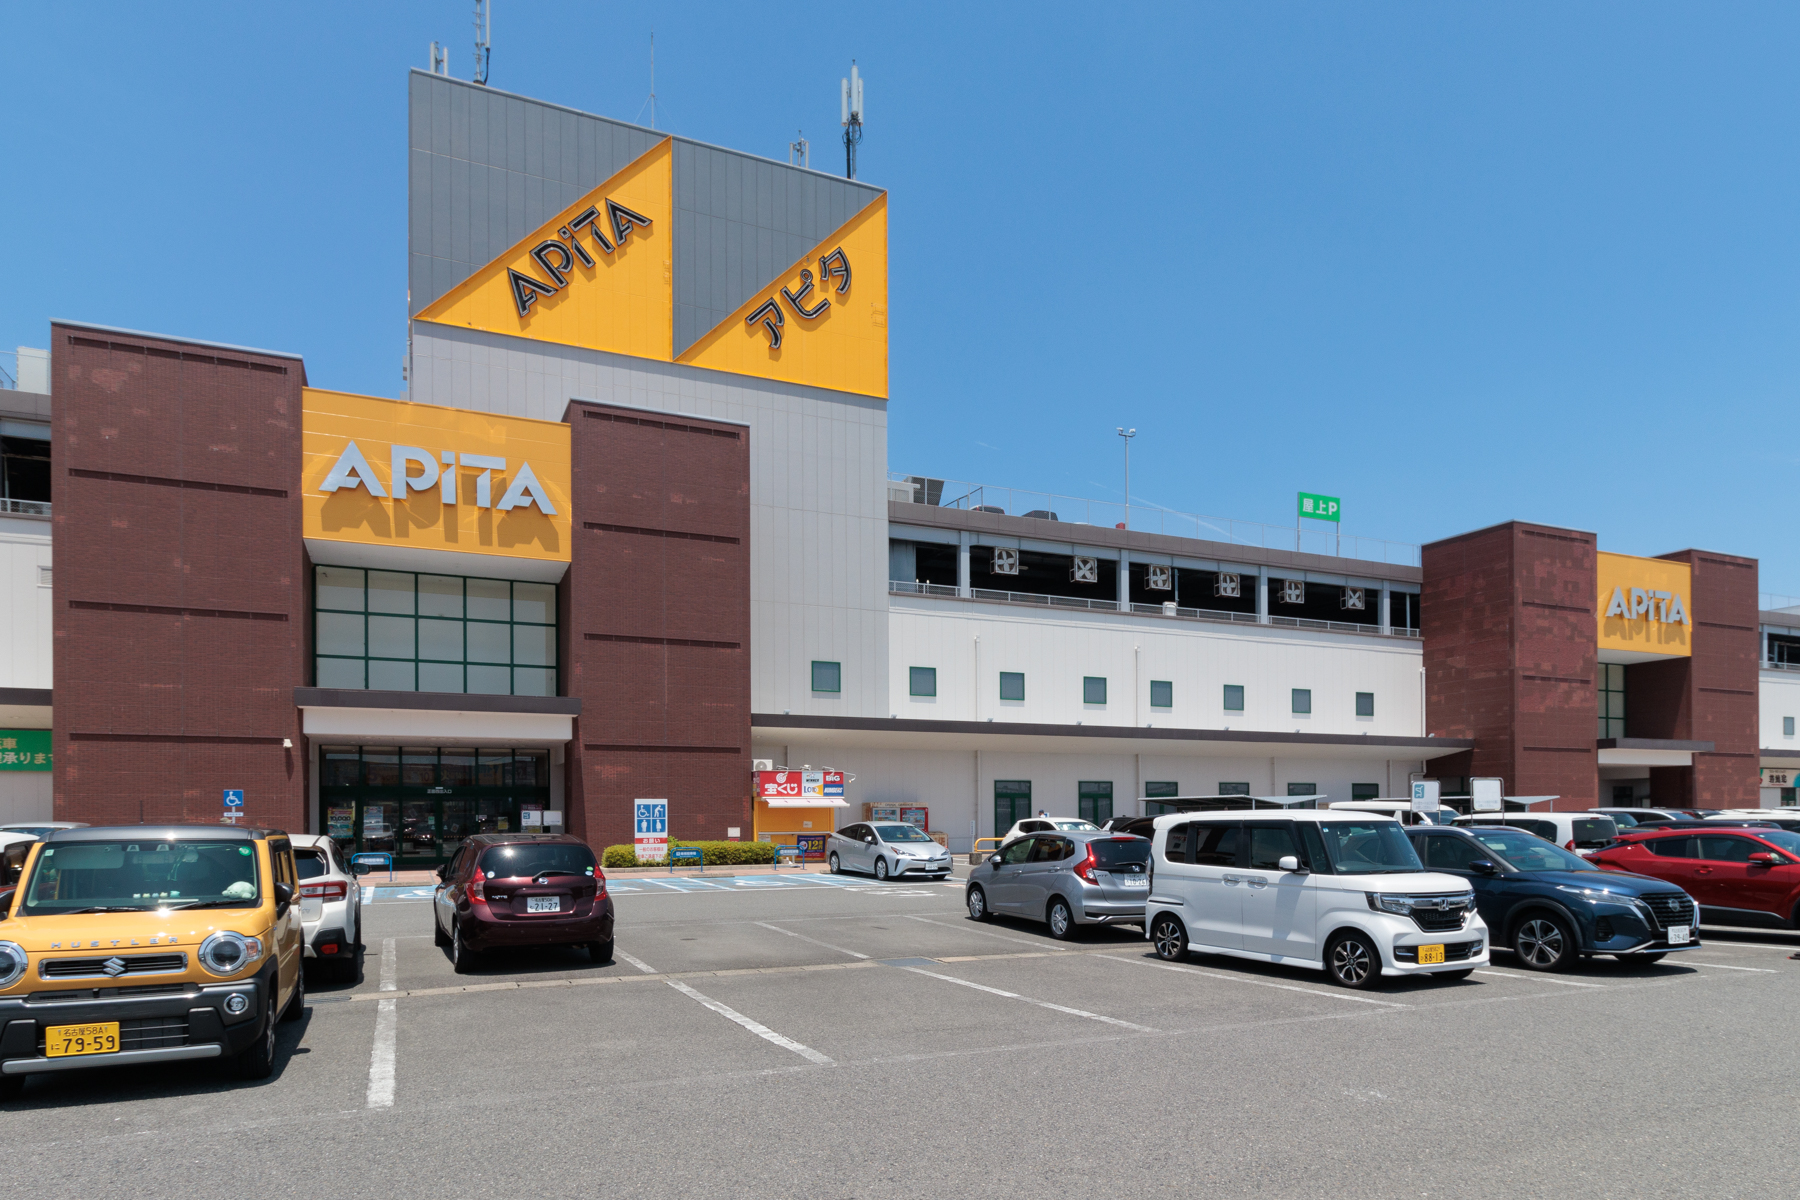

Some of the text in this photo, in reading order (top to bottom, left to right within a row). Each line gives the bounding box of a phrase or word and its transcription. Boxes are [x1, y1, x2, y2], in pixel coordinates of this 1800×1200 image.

[745, 246, 852, 350] アピタ
[1303, 498, 1338, 516] 屋上P
[0, 737, 18, 750] 車
[0, 752, 53, 764] 承りま
[764, 783, 798, 795] 宝くじ
[535, 902, 558, 911] 21-27
[51, 937, 178, 949] HUSTLER
[63, 1035, 115, 1053] 79-59
